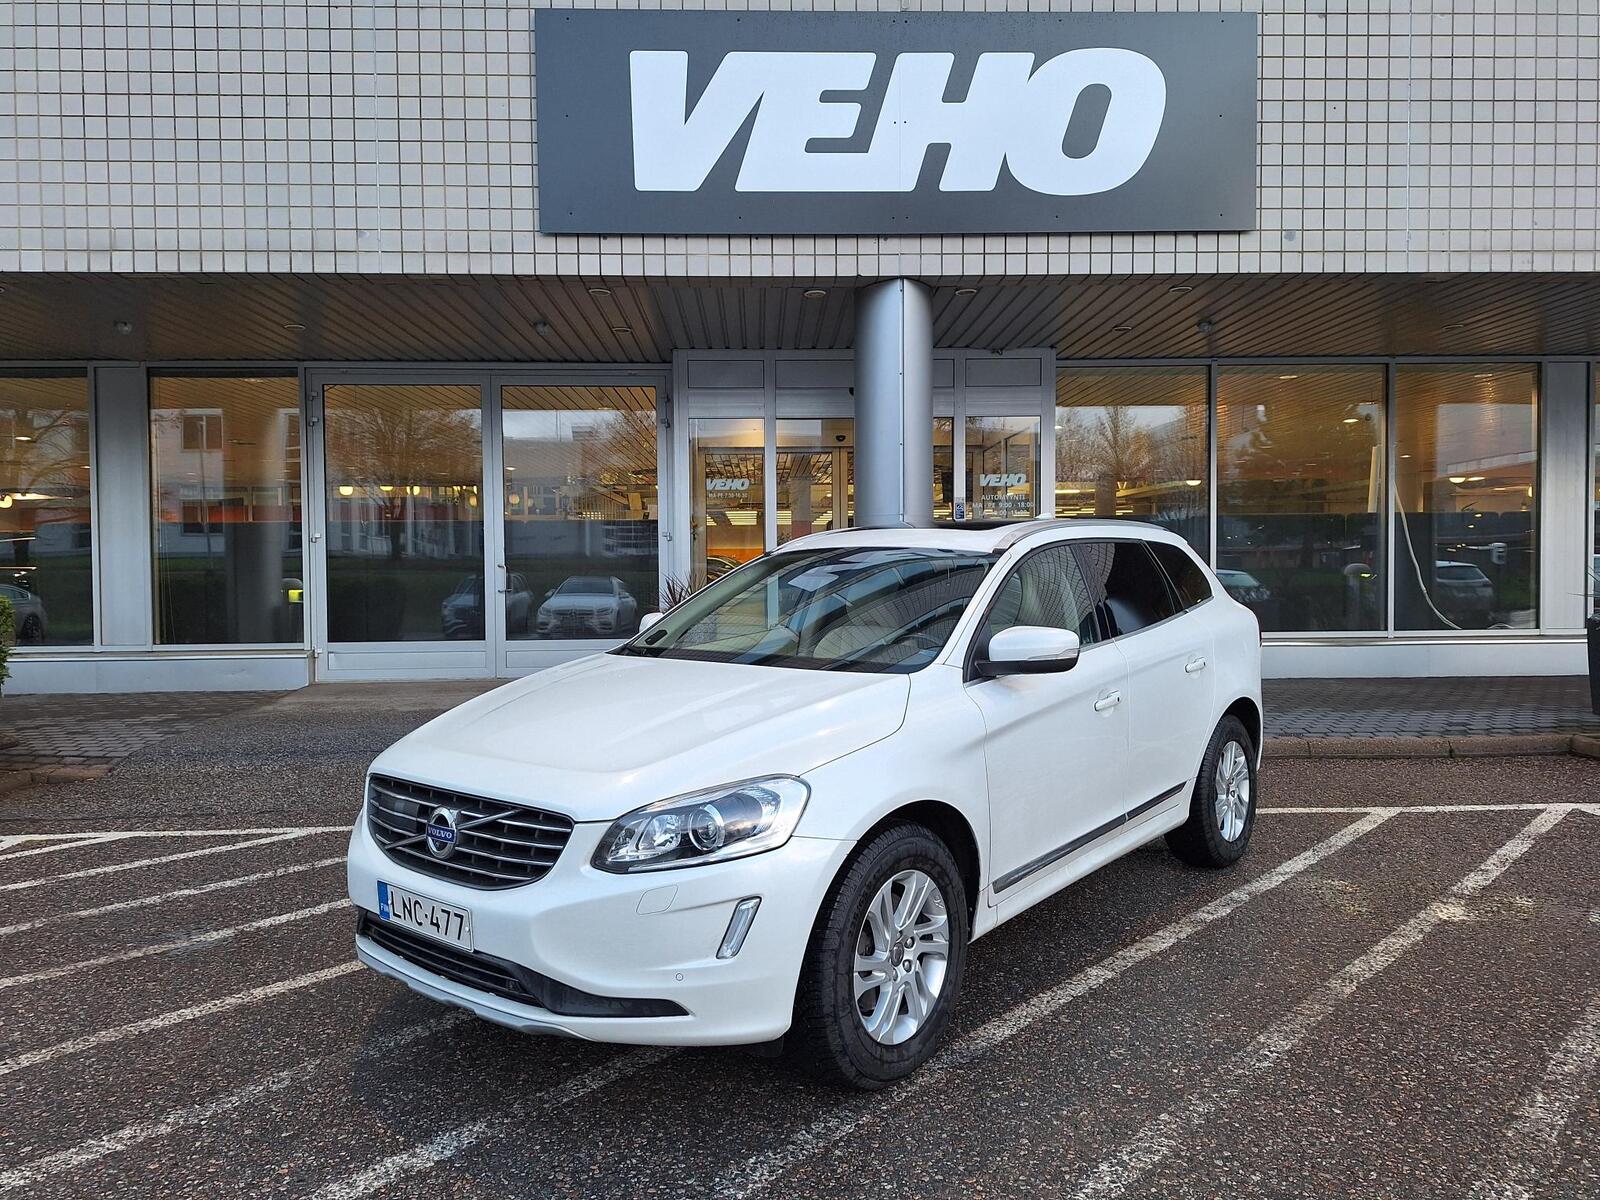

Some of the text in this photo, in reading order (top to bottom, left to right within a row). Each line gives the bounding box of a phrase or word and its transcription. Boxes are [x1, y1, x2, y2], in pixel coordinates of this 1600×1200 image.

[629, 47, 1167, 196] VEHO
[706, 478, 750, 490] VEHO
[980, 473, 1026, 487] VEHO
[427, 827, 452, 838] VOLVO
